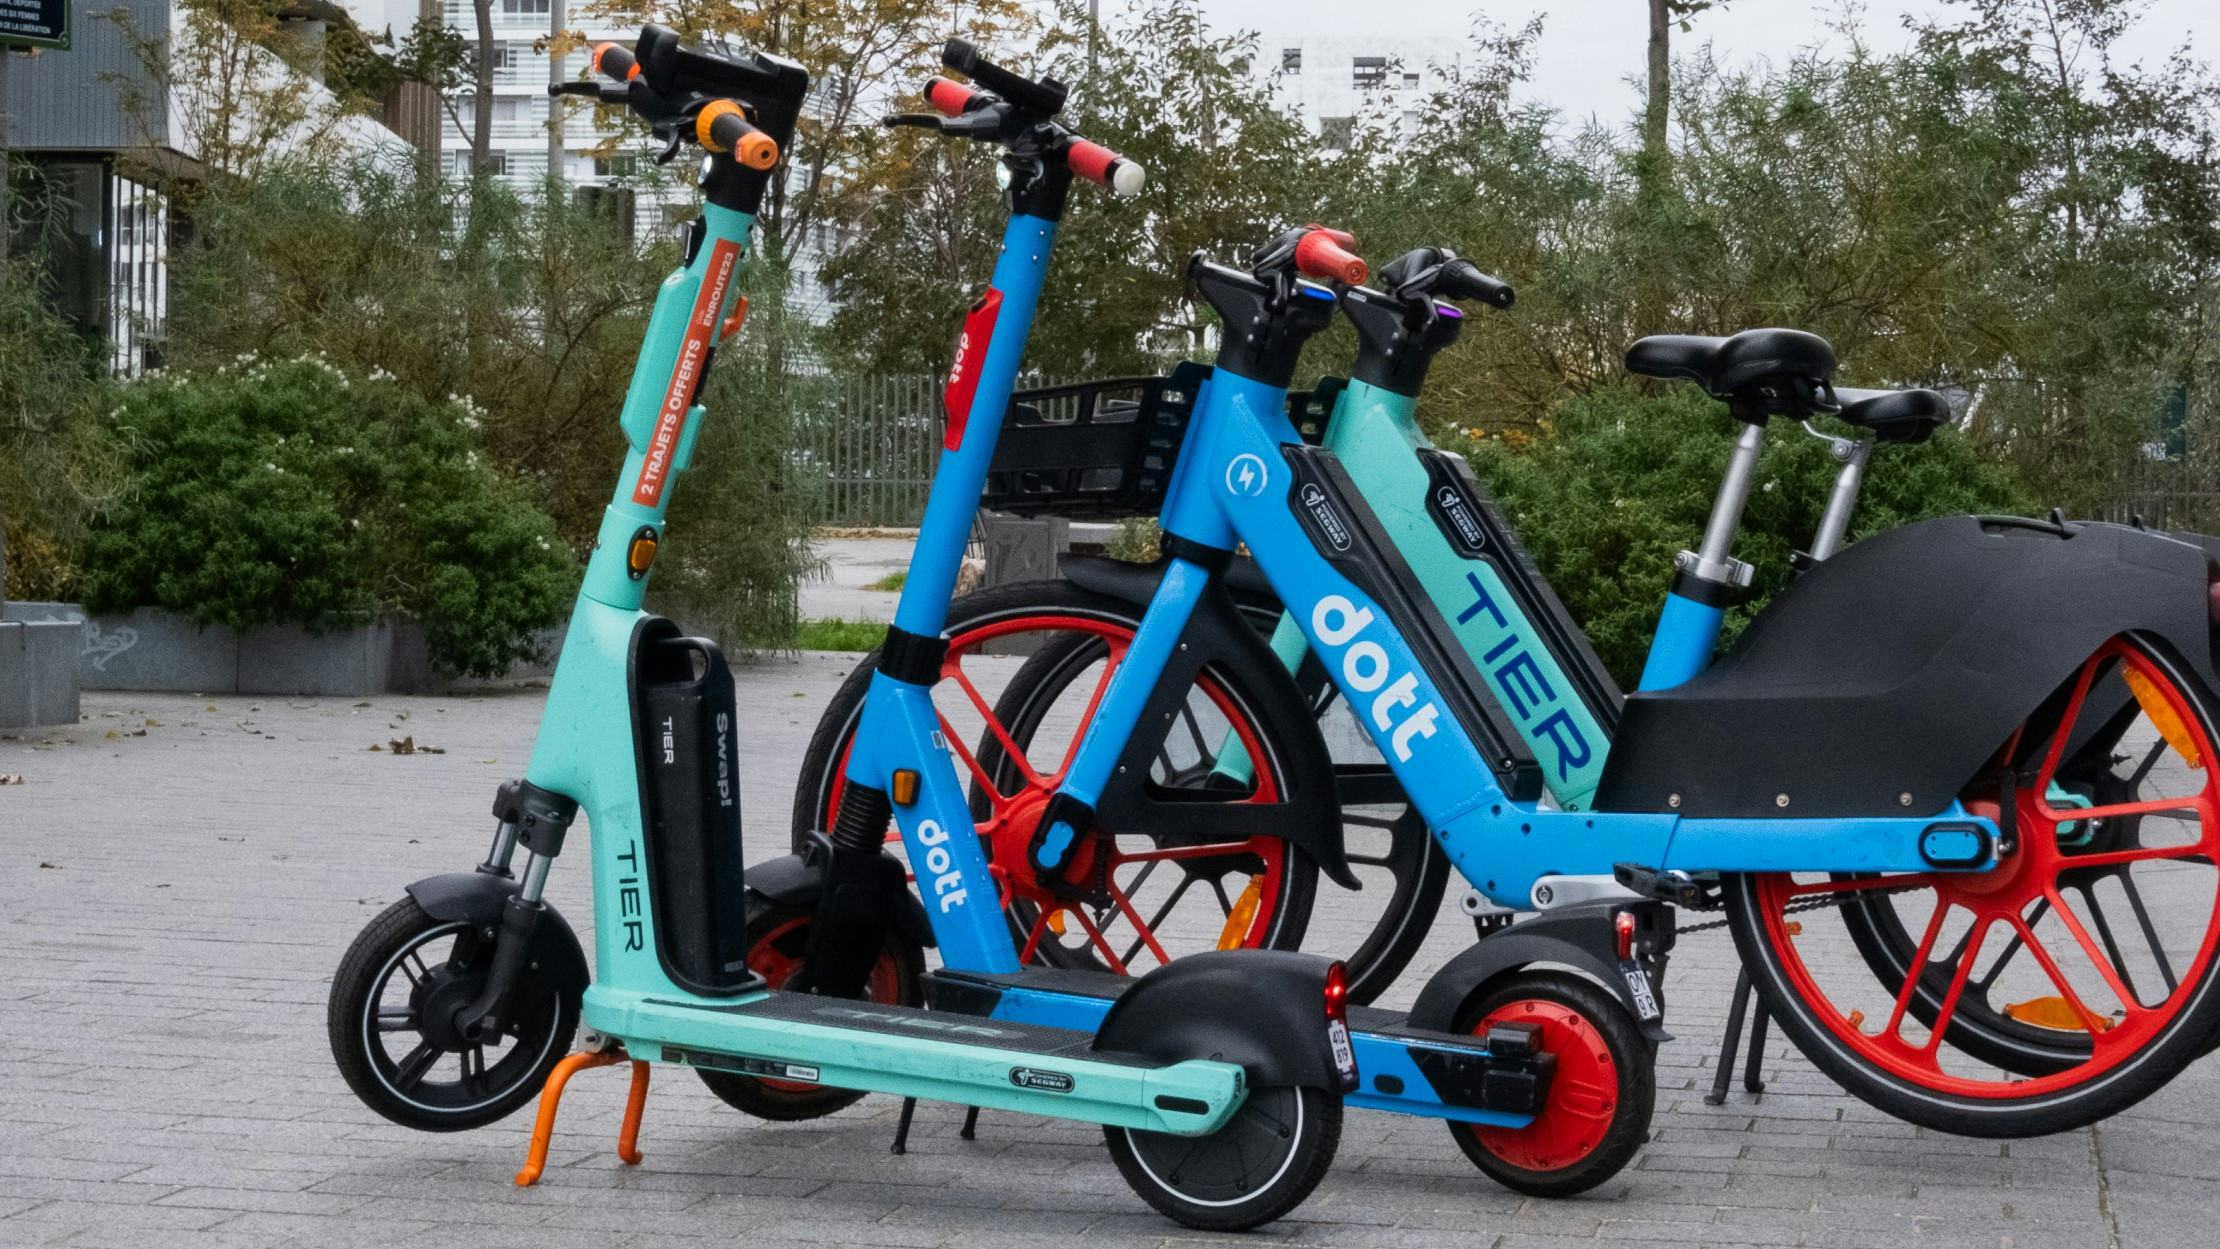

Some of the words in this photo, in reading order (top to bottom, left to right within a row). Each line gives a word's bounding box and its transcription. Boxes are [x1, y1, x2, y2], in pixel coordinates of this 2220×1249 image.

[703, 252, 734, 327] ENROUTE23
[669, 339, 701, 411] OFFERTS
[949, 332, 969, 384] dott
[644, 414, 677, 481] TRAJETS
[640, 481, 654, 495] 2
[1316, 507, 1343, 543] SEGWAY
[1451, 507, 1478, 542] SEGWAY
[1312, 594, 1440, 763] dott
[1456, 571, 1592, 783] TIER
[662, 716, 674, 765] TIER
[716, 712, 732, 807] Swapi
[617, 839, 645, 952] TIER
[917, 819, 969, 913] dott
[1031, 1077, 1067, 1090] SEGWAY
